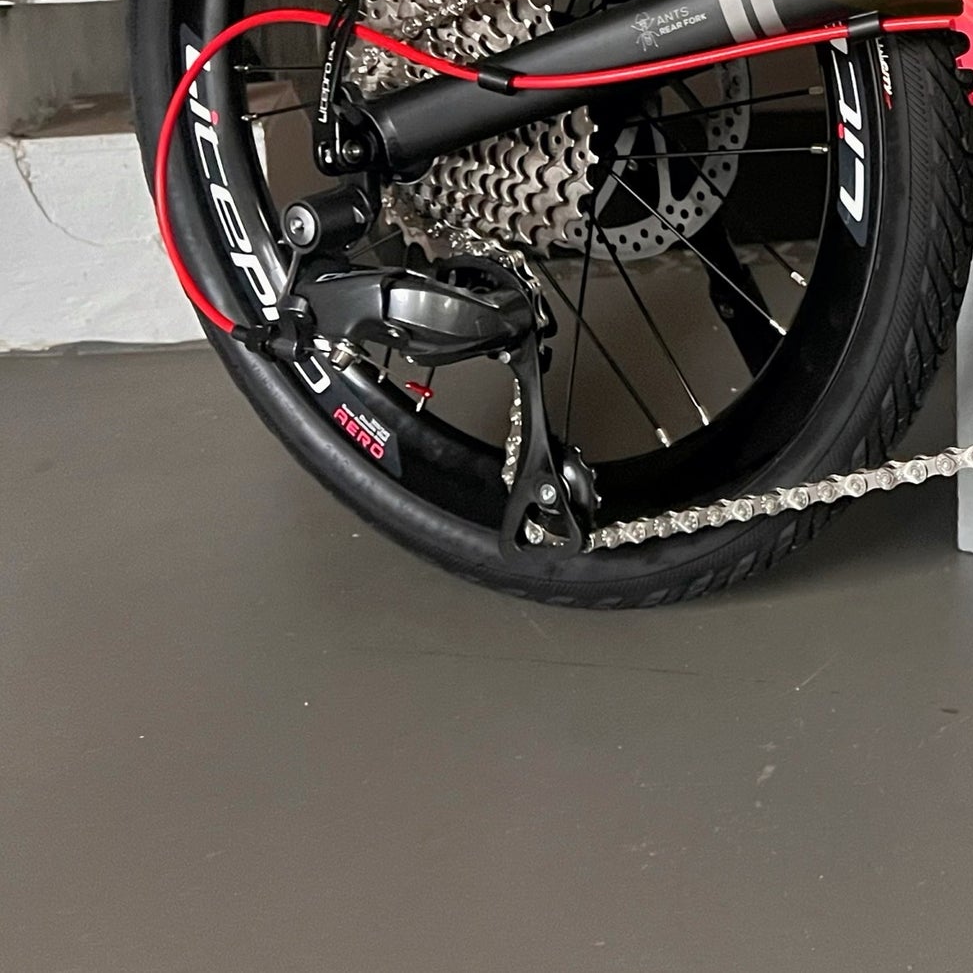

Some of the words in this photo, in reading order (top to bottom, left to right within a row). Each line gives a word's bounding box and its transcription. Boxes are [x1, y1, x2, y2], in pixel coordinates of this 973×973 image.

[657, 6, 689, 24] ANTS
[658, 22, 683, 35] REAR
[683, 13, 707, 26] FORK
[333, 407, 385, 460] AERO
